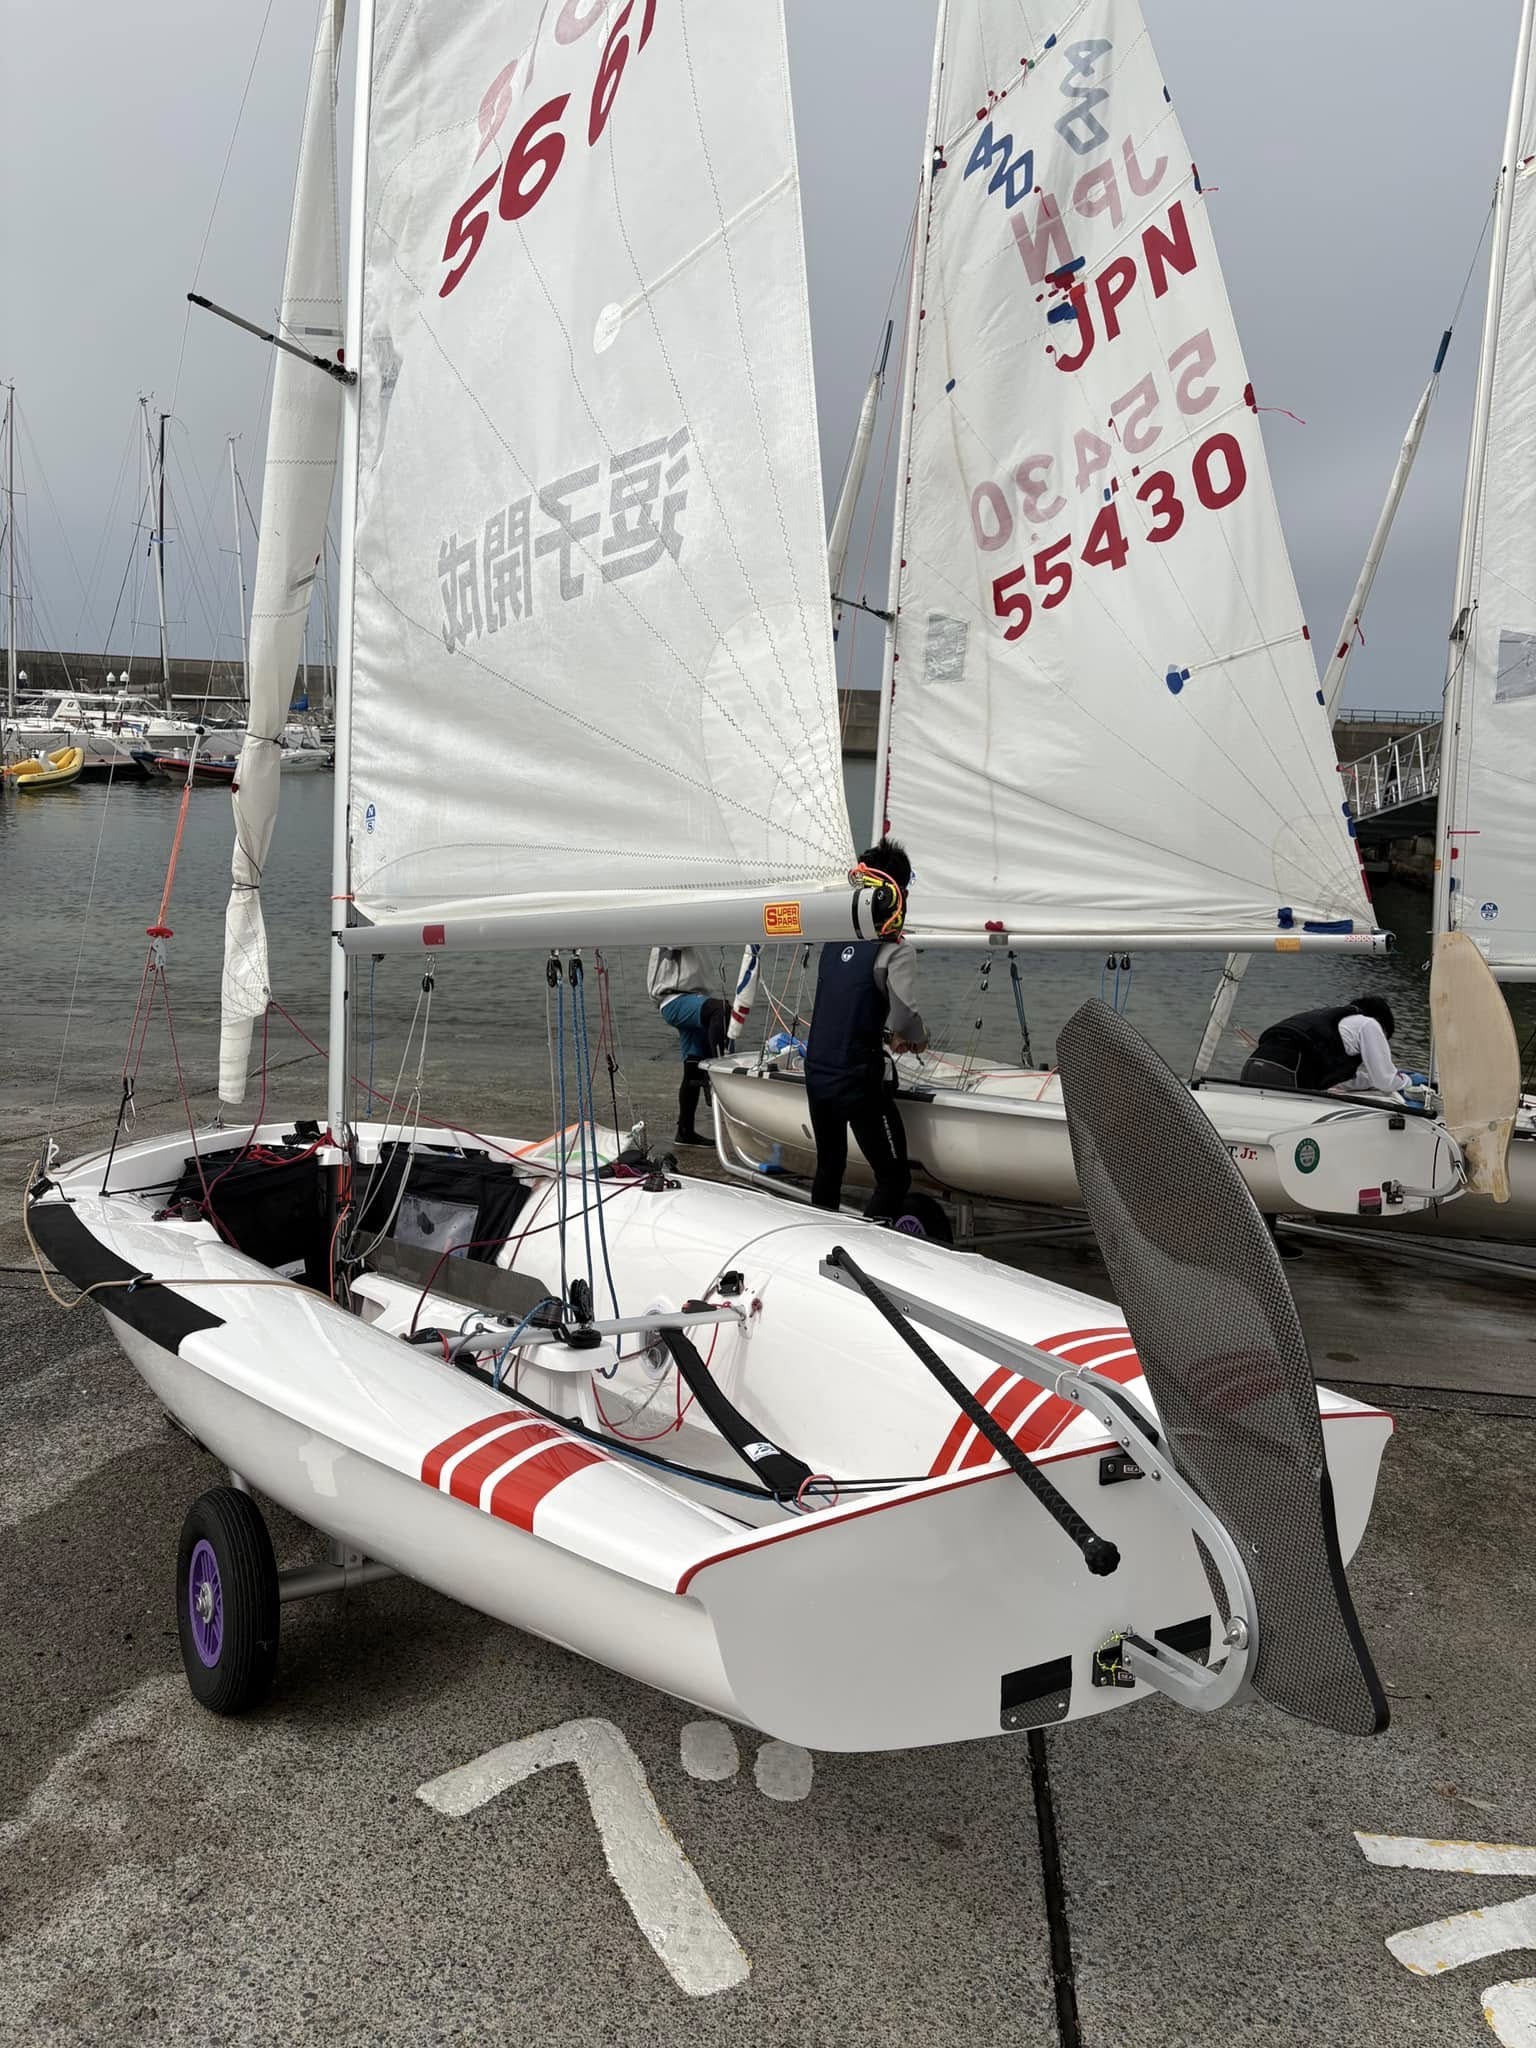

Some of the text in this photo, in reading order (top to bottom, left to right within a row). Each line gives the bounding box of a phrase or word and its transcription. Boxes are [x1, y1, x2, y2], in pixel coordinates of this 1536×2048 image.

[963, 121, 1034, 209] 420
[1054, 200, 1198, 373] JPN
[992, 432, 1247, 641] 55430
